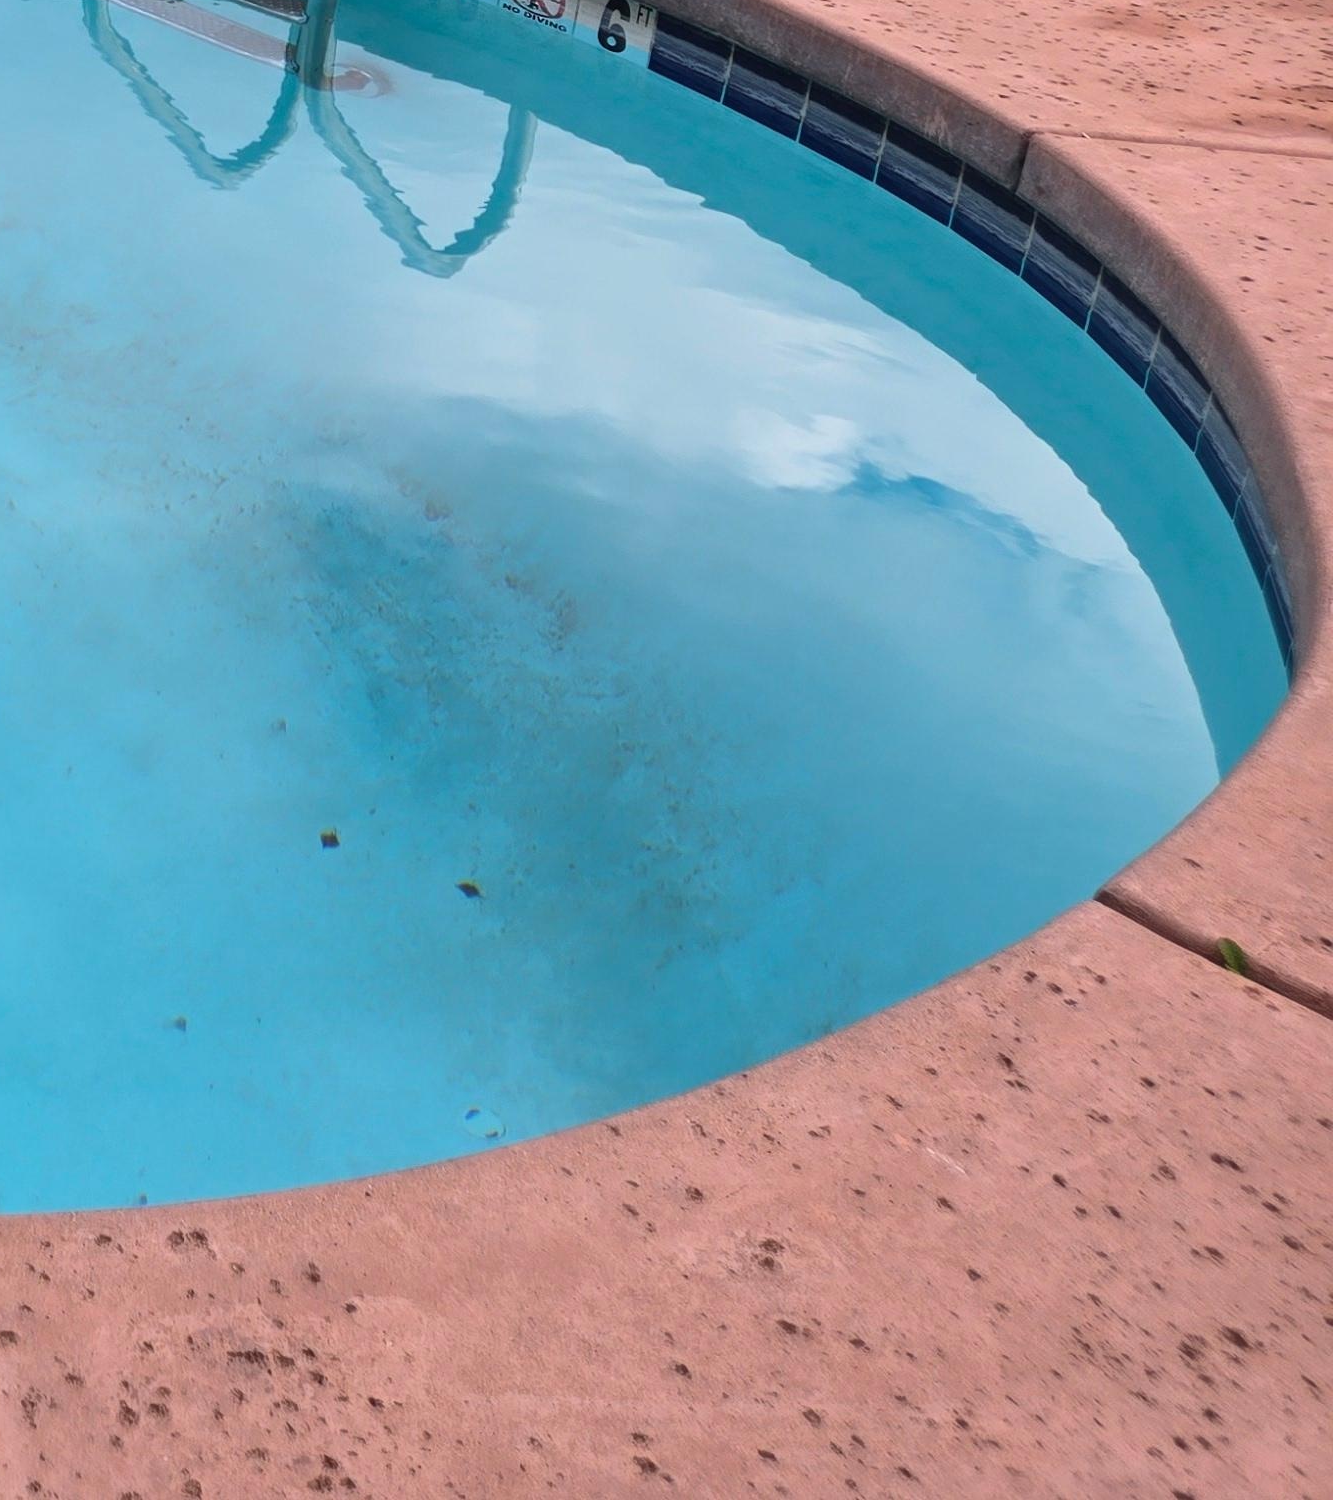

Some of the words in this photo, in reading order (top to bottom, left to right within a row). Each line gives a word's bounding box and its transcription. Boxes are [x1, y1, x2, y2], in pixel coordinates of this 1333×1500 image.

[502, 2, 521, 15] NO
[522, 10, 568, 33] DIVING
[636, 3, 654, 28] FT
